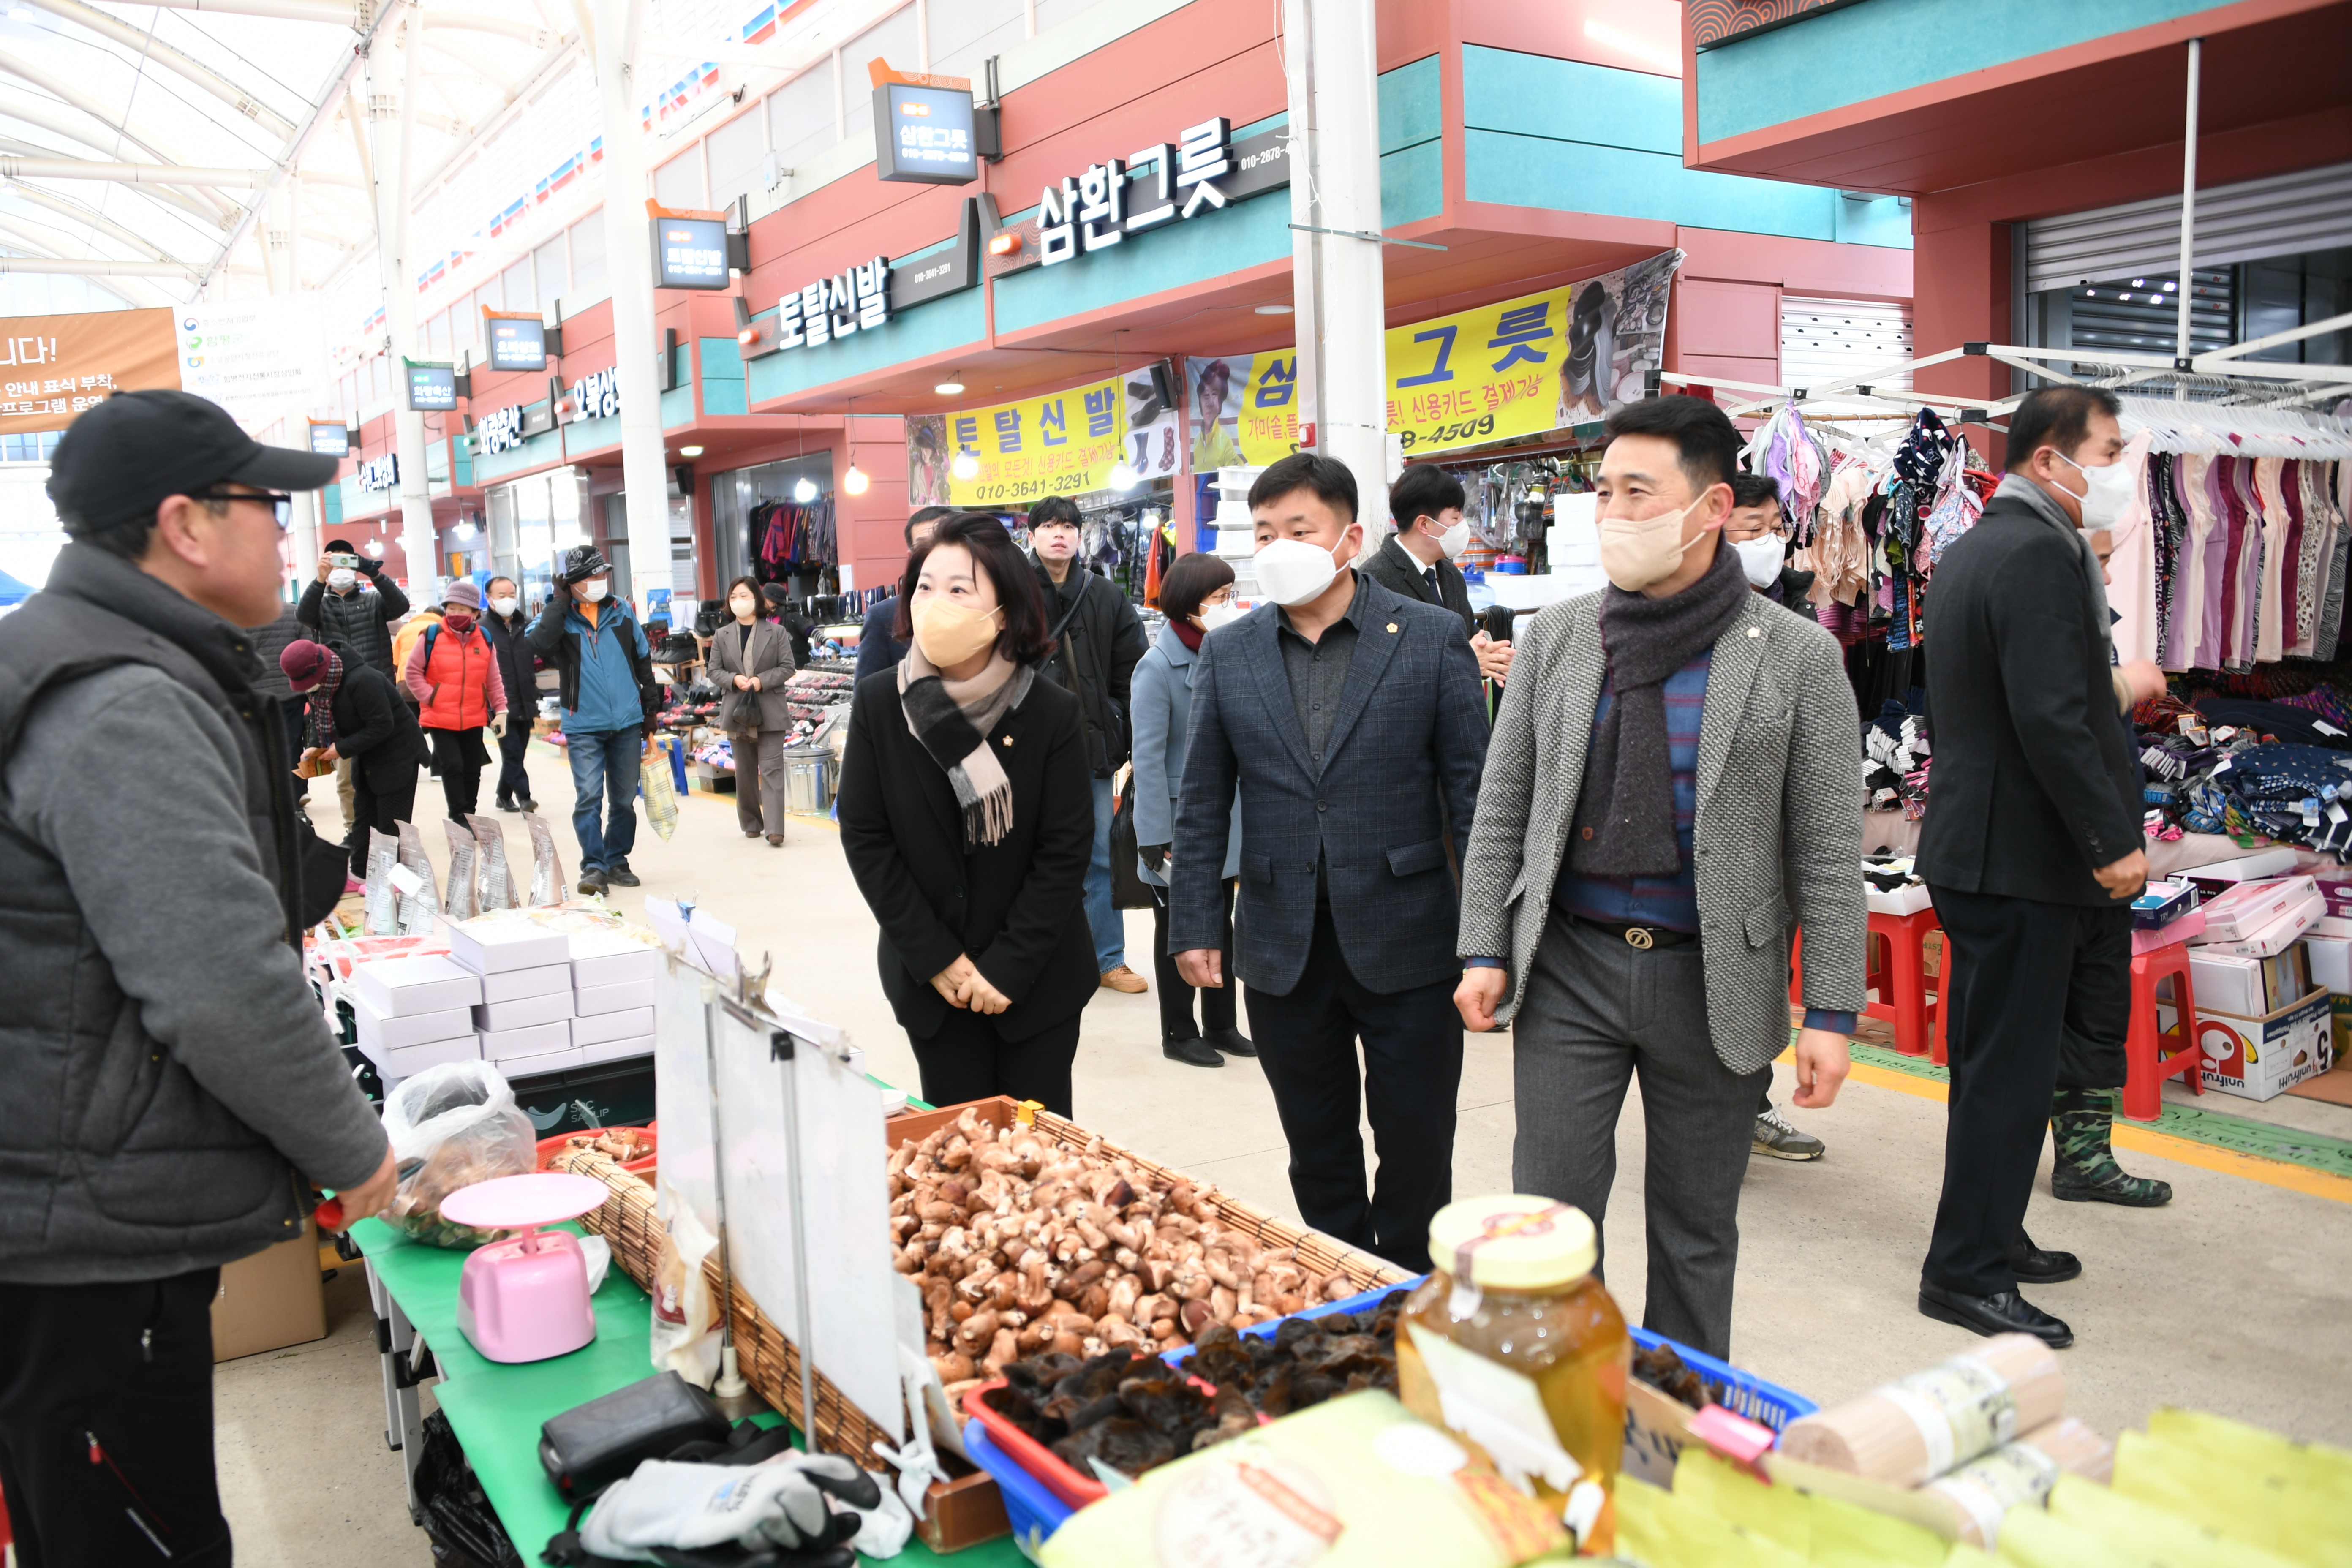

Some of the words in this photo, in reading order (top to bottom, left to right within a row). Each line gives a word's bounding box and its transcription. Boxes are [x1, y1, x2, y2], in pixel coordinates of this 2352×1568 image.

[900, 125, 967, 149] 삼환그릇
[1036, 116, 1229, 266] 삼환그릇
[779, 255, 887, 350] 토탈신발
[207, 333, 243, 347] 함평군
[5, 381, 39, 398] 안내
[44, 377, 76, 393] 표식
[80, 373, 117, 391] 부착,
[1412, 389, 1477, 423] 신용카드
[1038, 451, 1075, 475] 신용카드
[976, 470, 1091, 500] 010-3641-3291
[2201, 1072, 2245, 1089] unifrut
[2279, 1064, 2311, 1089] unifrutti
